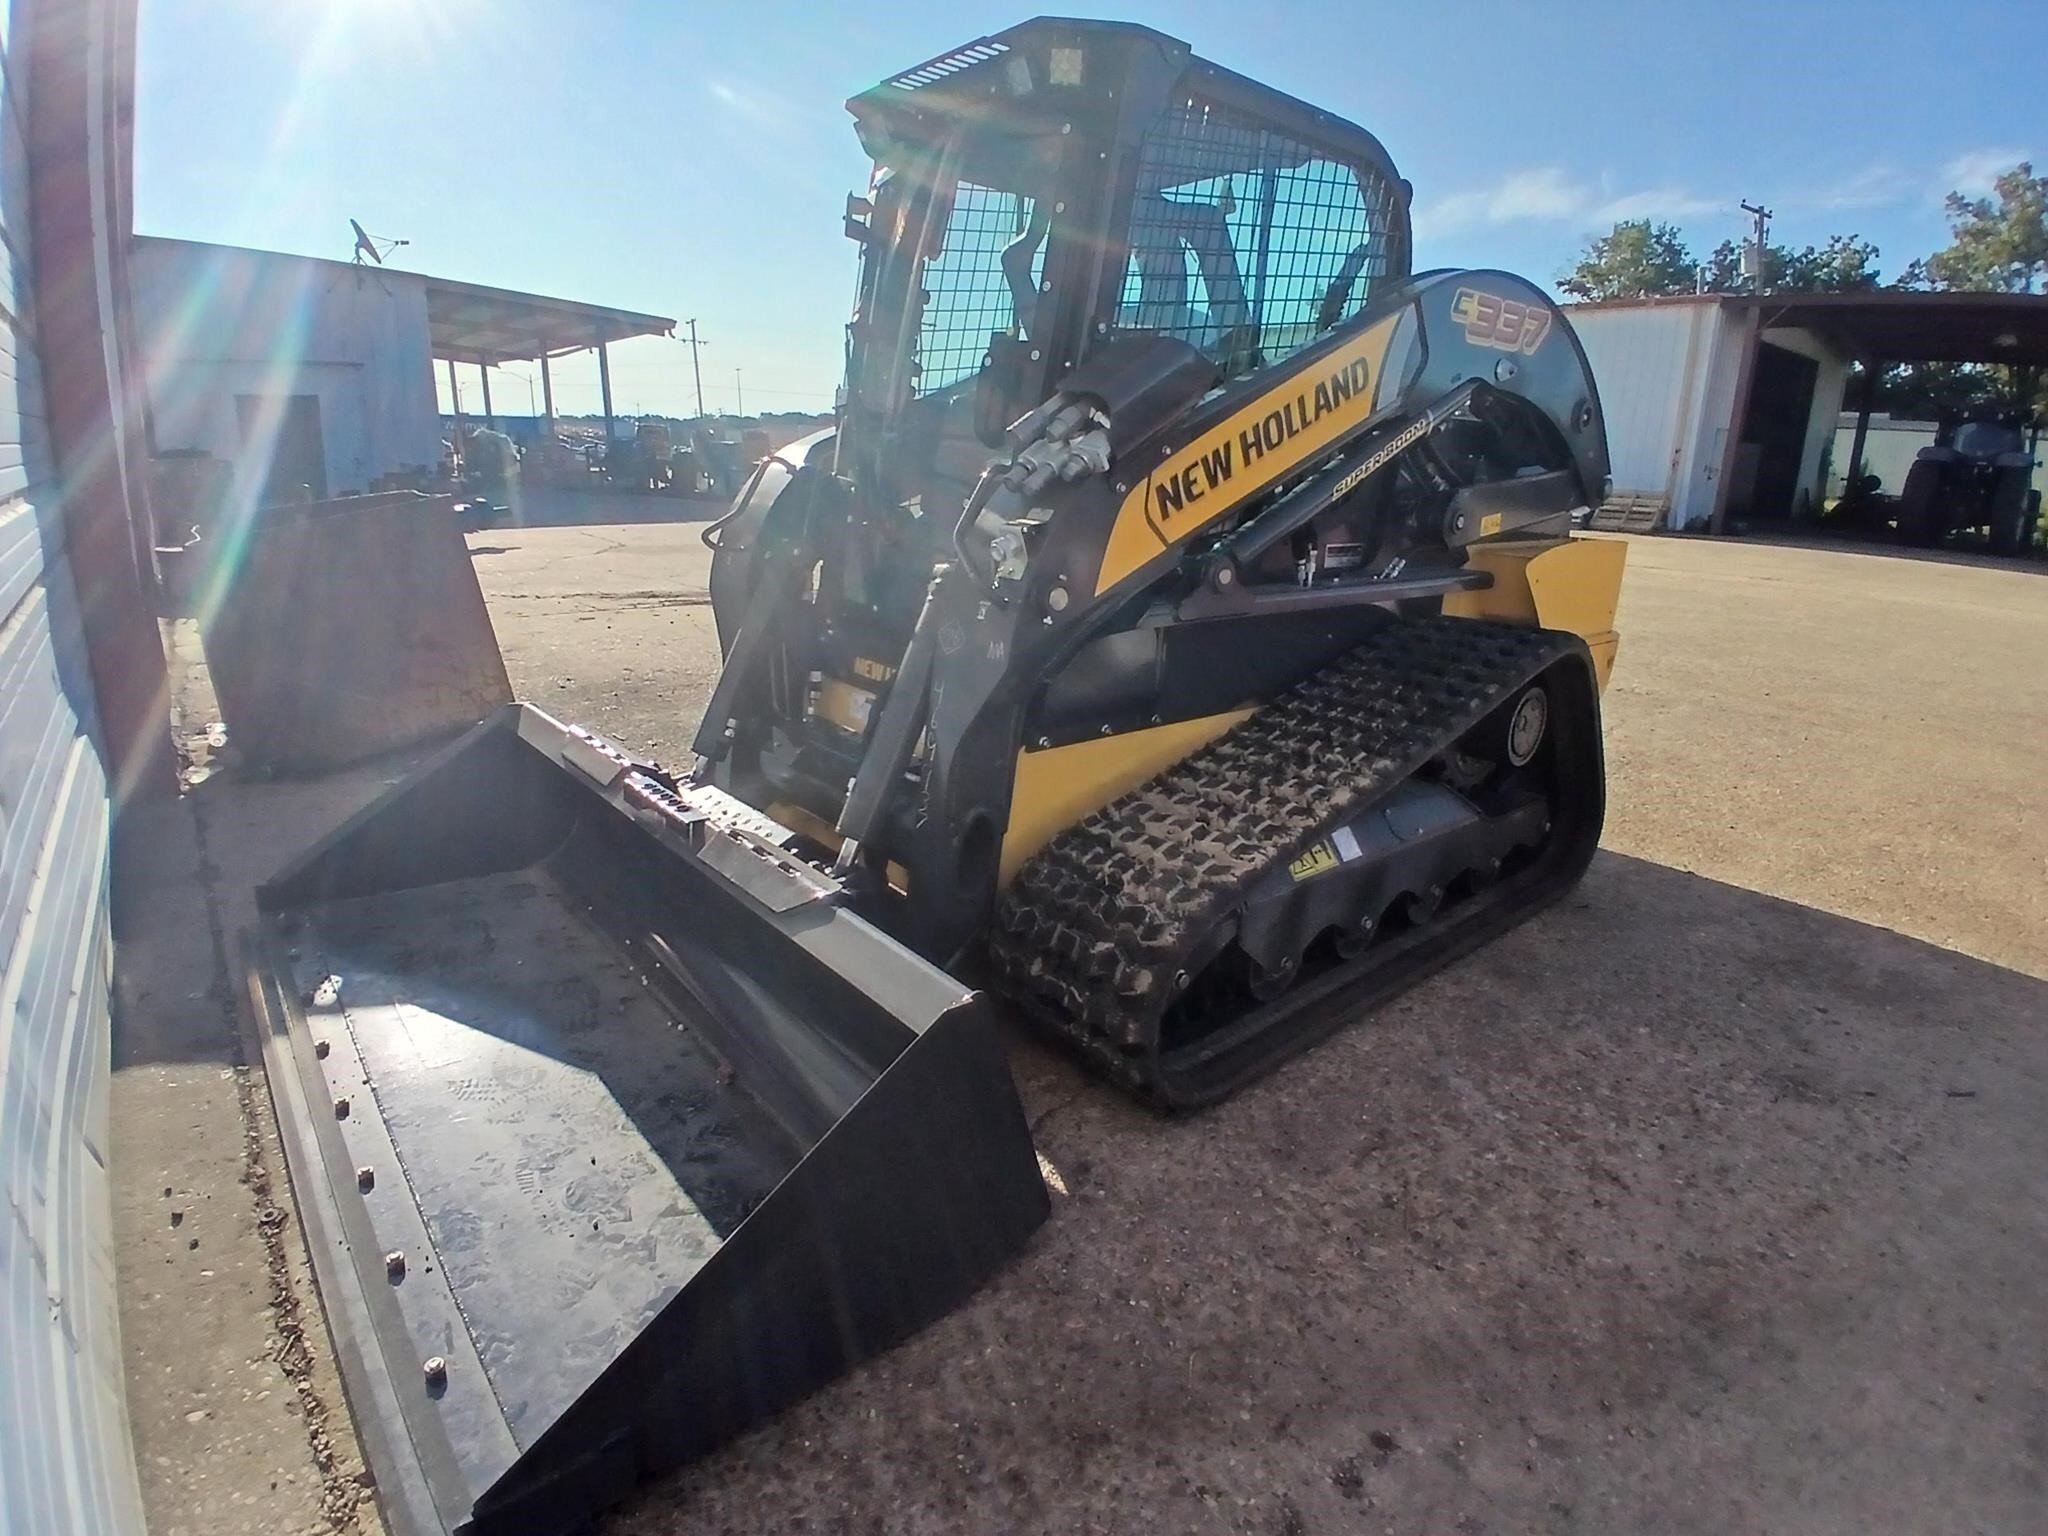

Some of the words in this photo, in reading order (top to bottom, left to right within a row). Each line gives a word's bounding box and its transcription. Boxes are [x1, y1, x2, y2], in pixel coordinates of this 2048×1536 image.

[1155, 440, 1233, 521] NEW
[1239, 356, 1370, 468] HOLLAND
[1332, 452, 1384, 501] SUPER
